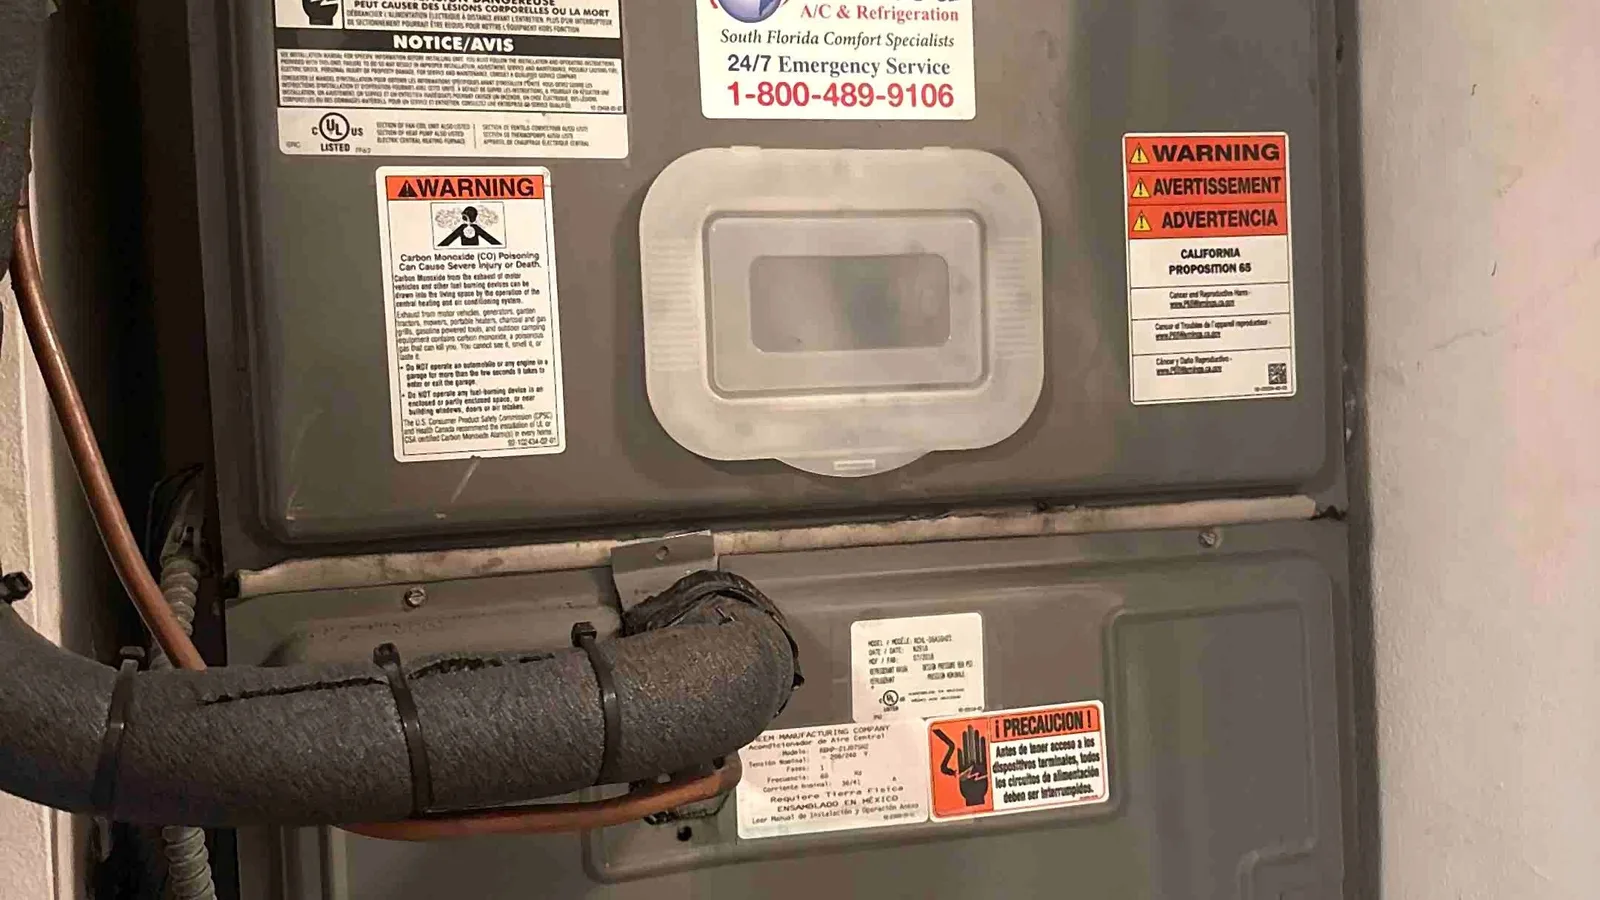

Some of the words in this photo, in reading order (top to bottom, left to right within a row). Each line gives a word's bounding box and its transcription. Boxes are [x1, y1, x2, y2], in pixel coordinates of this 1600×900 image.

[381, 2, 419, 10] CAUSER
[421, 3, 439, 11] DES
[485, 5, 549, 15] CORPORELLES
[552, 7, 567, 16] OU
[569, 8, 581, 16] LA
[583, 9, 610, 17] MORT
[800, 4, 831, 19] A/C
[836, 4, 850, 19] &
[857, 4, 959, 24] Refrigeration
[393, 34, 515, 52] NOTICE/AVIS
[720, 29, 761, 44] South
[767, 30, 819, 45] Florida
[824, 31, 881, 50] Comfort
[885, 33, 955, 50] Specialists
[727, 54, 772, 72] 24/7
[778, 55, 880, 78] Emergency
[886, 57, 950, 75] Service
[727, 81, 954, 108] 1-800-489-9106
[320, 143, 350, 152] LISTED
[1152, 143, 1280, 162] WARNING
[417, 178, 534, 197] WARNING
[1153, 176, 1282, 196] AVERTISSEMENT
[1162, 209, 1278, 229] ADVERTENCIA
[400, 254, 431, 262] Carbon
[434, 253, 475, 261] Monoxide
[477, 252, 496, 263] (CO)
[499, 252, 539, 262] Poisoning
[1180, 248, 1241, 259] CALIFORNIA
[399, 263, 416, 271] Can
[419, 262, 445, 270] Cause
[447, 262, 476, 270] Severe
[479, 261, 502, 271] Injury
[1169, 263, 1237, 276] PROPOSITION
[1239, 262, 1252, 273] 65
[779, 729, 849, 740] MANUFACTURING
[853, 725, 890, 734] COMPANY
[1003, 711, 1083, 738] PRECAUCION
[996, 746, 1016, 758] Antes
[1018, 743, 1027, 755] de
[1029, 742, 1049, 754] tener
[1051, 740, 1075, 752] acceso
[1078, 739, 1082, 749] a
[1084, 736, 1095, 748] los
[992, 759, 1036, 774] dispositivos
[1038, 754, 1079, 768] terminales,
[1080, 751, 1100, 763] todos
[995, 776, 1006, 789] los
[1008, 773, 1040, 787] circuitos
[1042, 771, 1051, 783] de
[1003, 790, 1026, 803] deben
[1027, 790, 1039, 800] ser
